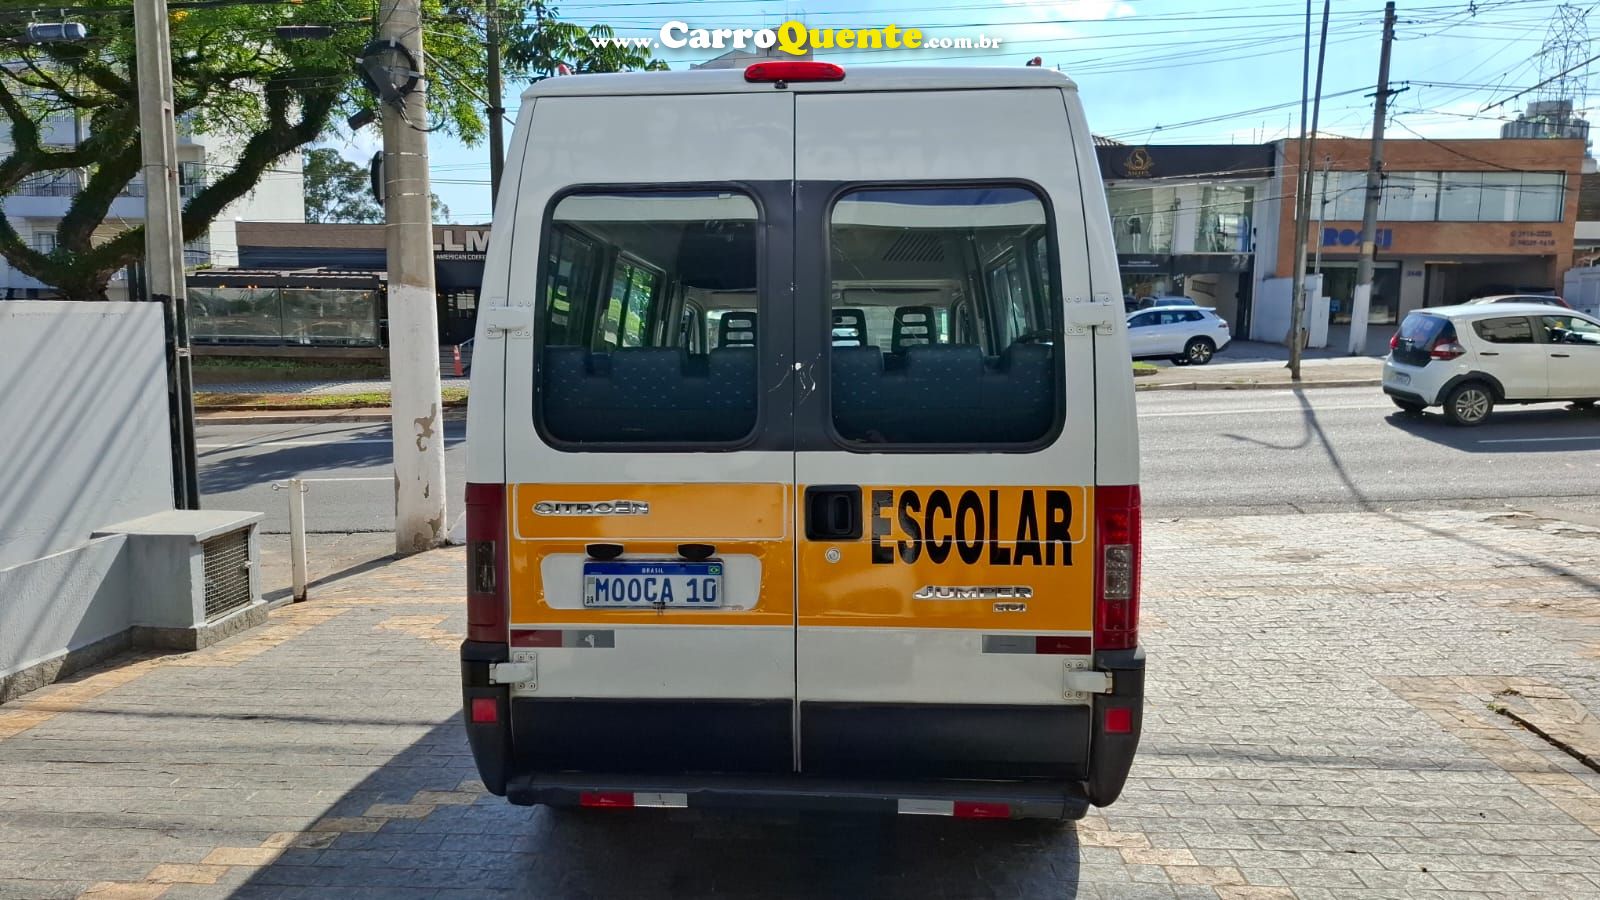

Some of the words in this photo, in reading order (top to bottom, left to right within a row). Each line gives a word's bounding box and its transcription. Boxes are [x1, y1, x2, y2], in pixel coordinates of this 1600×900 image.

[871, 489, 1073, 566] ESCOLAR
[595, 577, 674, 603] MOOCA
[914, 585, 1033, 599] JUMPER
